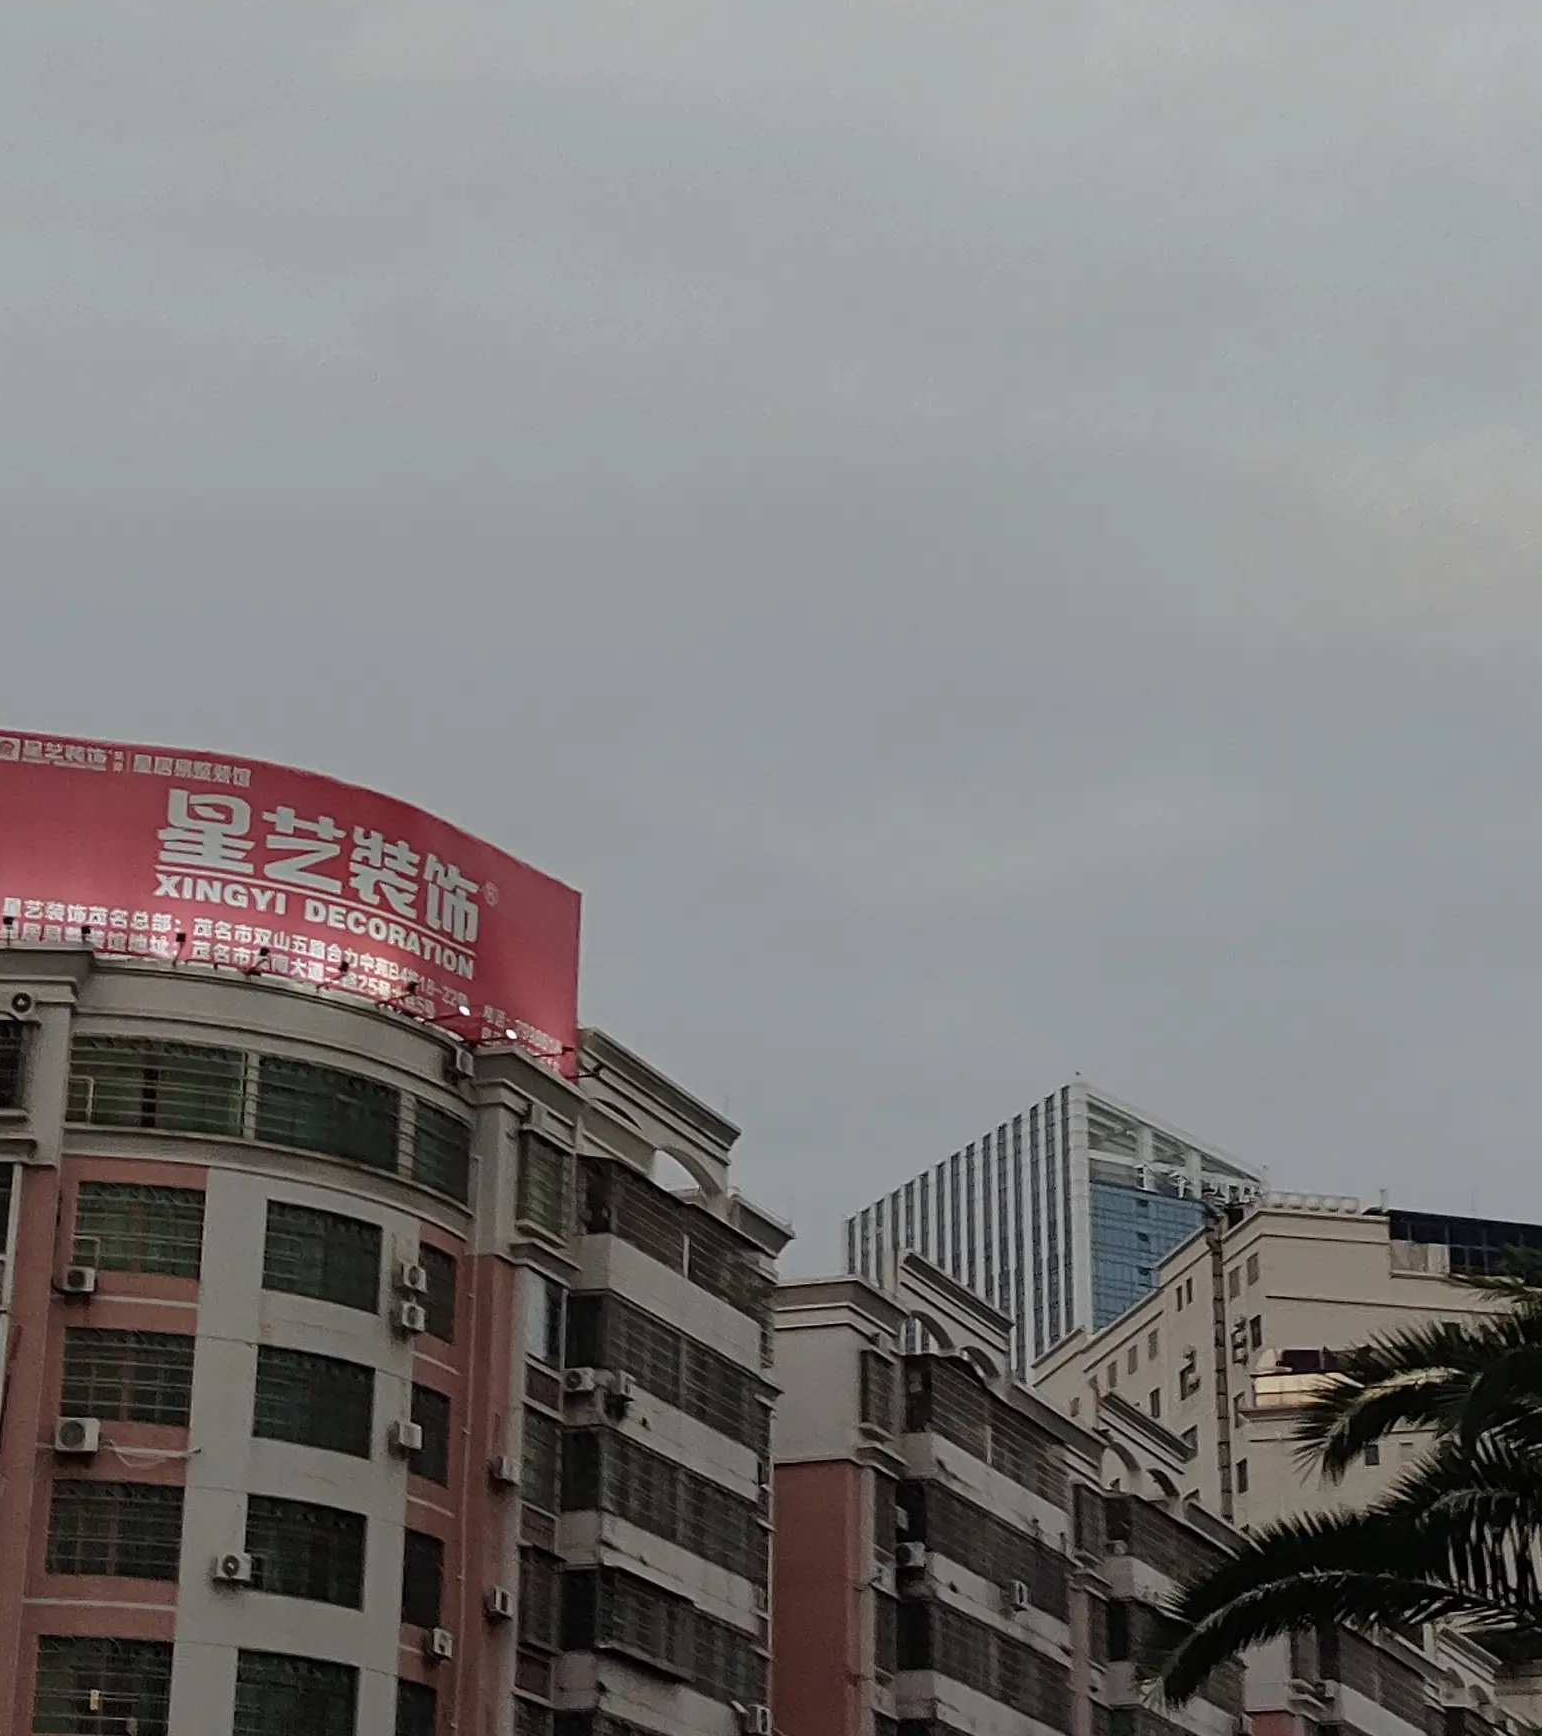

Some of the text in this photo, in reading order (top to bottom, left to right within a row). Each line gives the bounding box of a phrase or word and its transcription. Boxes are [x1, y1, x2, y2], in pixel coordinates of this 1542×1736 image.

[153, 873, 476, 981] XINGYI DECORATION
[157, 788, 480, 943] 星艺装饰
